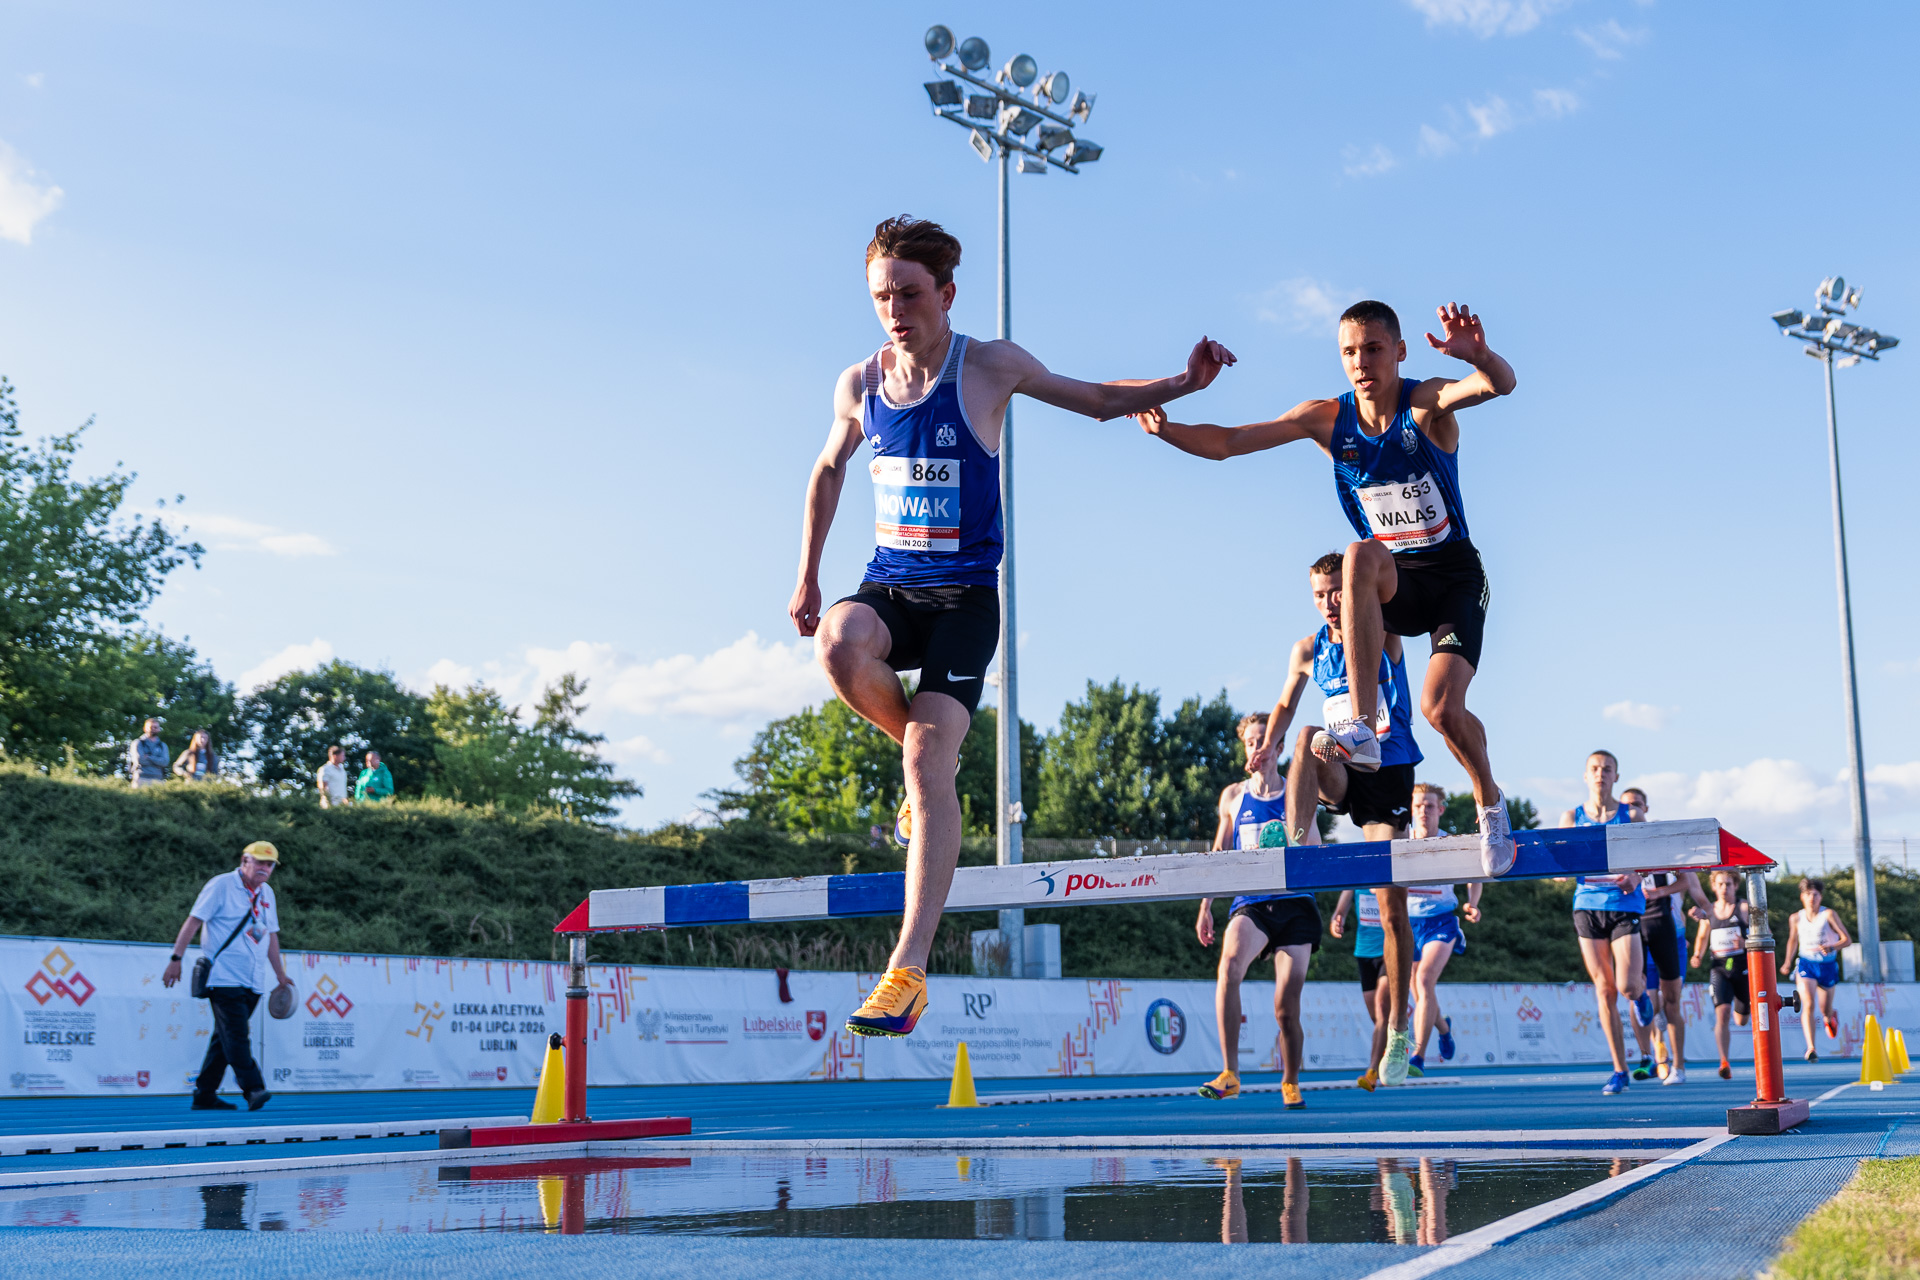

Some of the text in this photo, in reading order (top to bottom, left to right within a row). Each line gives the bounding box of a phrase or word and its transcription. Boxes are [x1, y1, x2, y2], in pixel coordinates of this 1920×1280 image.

[912, 463, 950, 482] 866
[1402, 481, 1431, 499] 653
[878, 493, 950, 518] NOWAK
[1376, 504, 1437, 527] WALAS
[912, 540, 932, 548] 2026
[1418, 536, 1437, 545] 2026
[453, 1002, 544, 1016] LEKKA ATLETYKA
[963, 993, 993, 1020] RP
[664, 1012, 713, 1021] Ministerstwo
[451, 1021, 546, 1033] 01-04 LIPCA 2026
[696, 1024, 728, 1034] Turystyki
[743, 1016, 803, 1032] Lubelskie
[942, 1025, 1019, 1036] Patronat Honorowy
[24, 1031, 96, 1045] LUBELSKIE
[303, 1037, 354, 1048] LUBELSKIE
[480, 1039, 517, 1051] LUBLIN
[317, 1049, 340, 1060] 2026
[273, 1068, 292, 1082] RP
